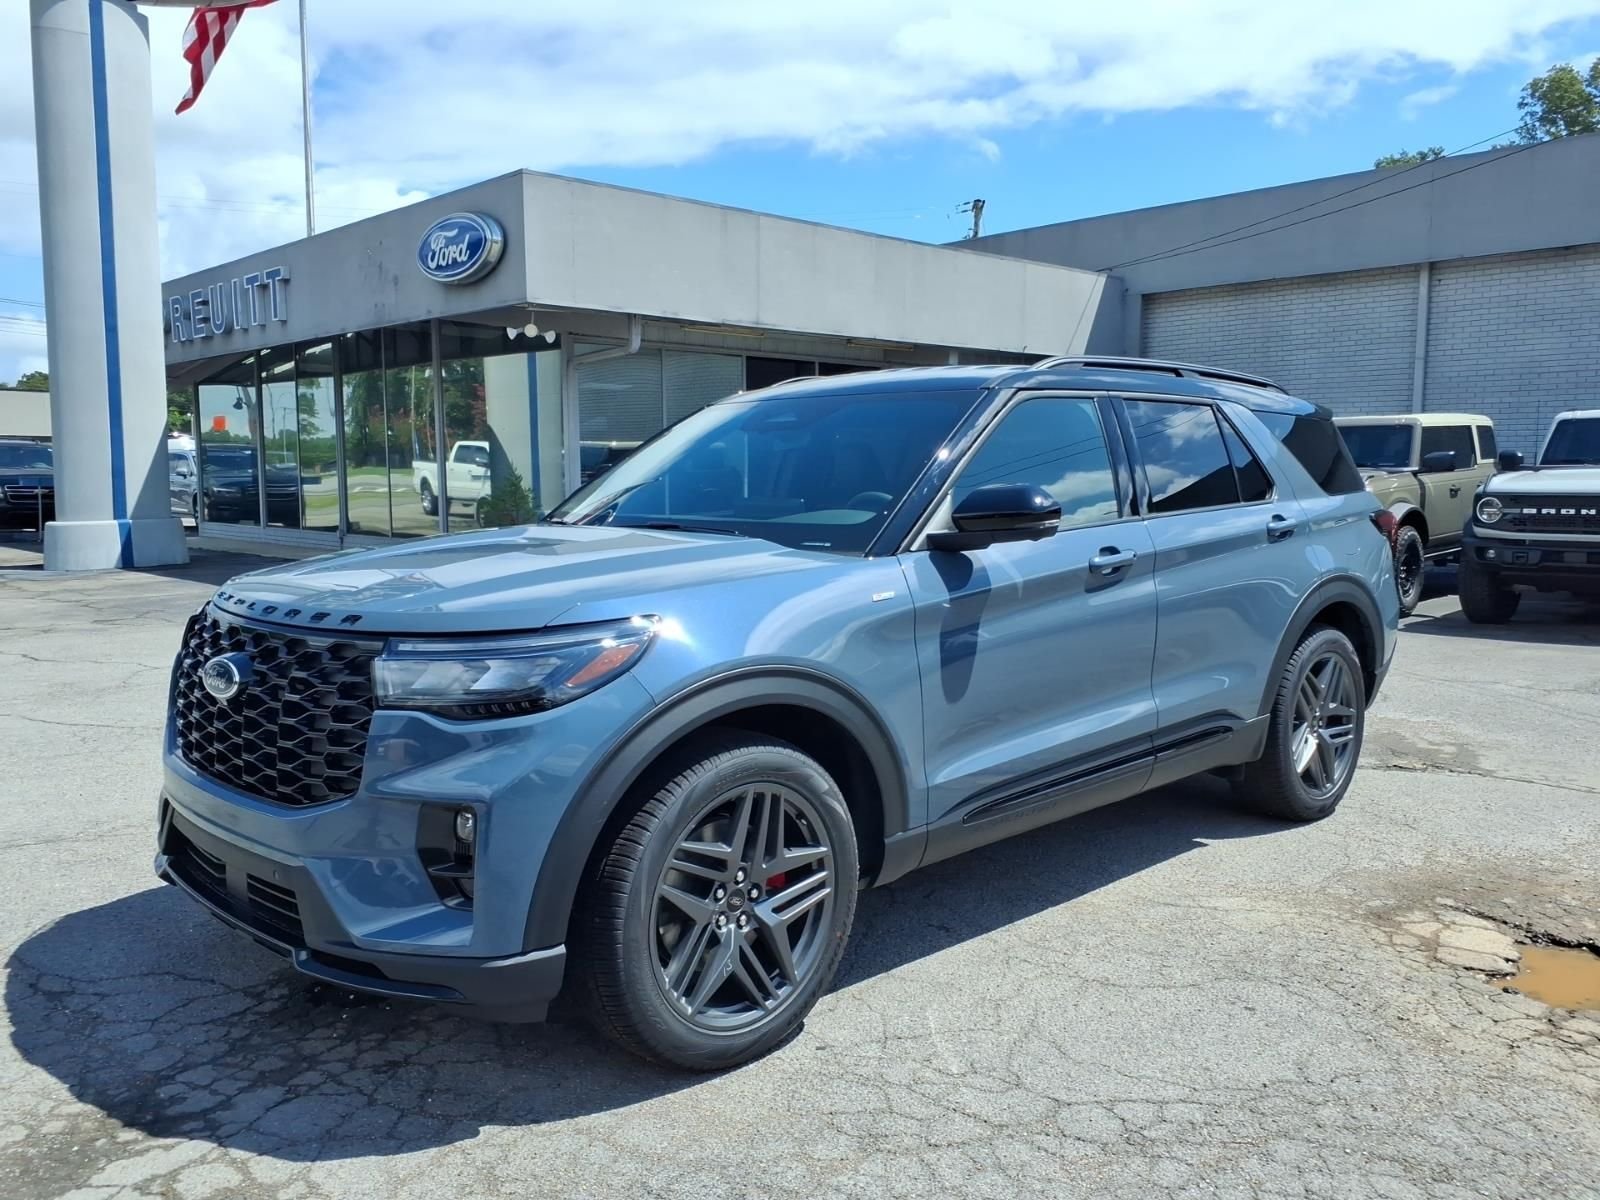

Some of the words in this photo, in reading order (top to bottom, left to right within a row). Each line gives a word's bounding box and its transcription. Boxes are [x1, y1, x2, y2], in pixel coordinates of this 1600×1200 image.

[428, 228, 470, 269] Ford
[167, 265, 289, 343] REUITT
[216, 590, 363, 626] EXPLORER
